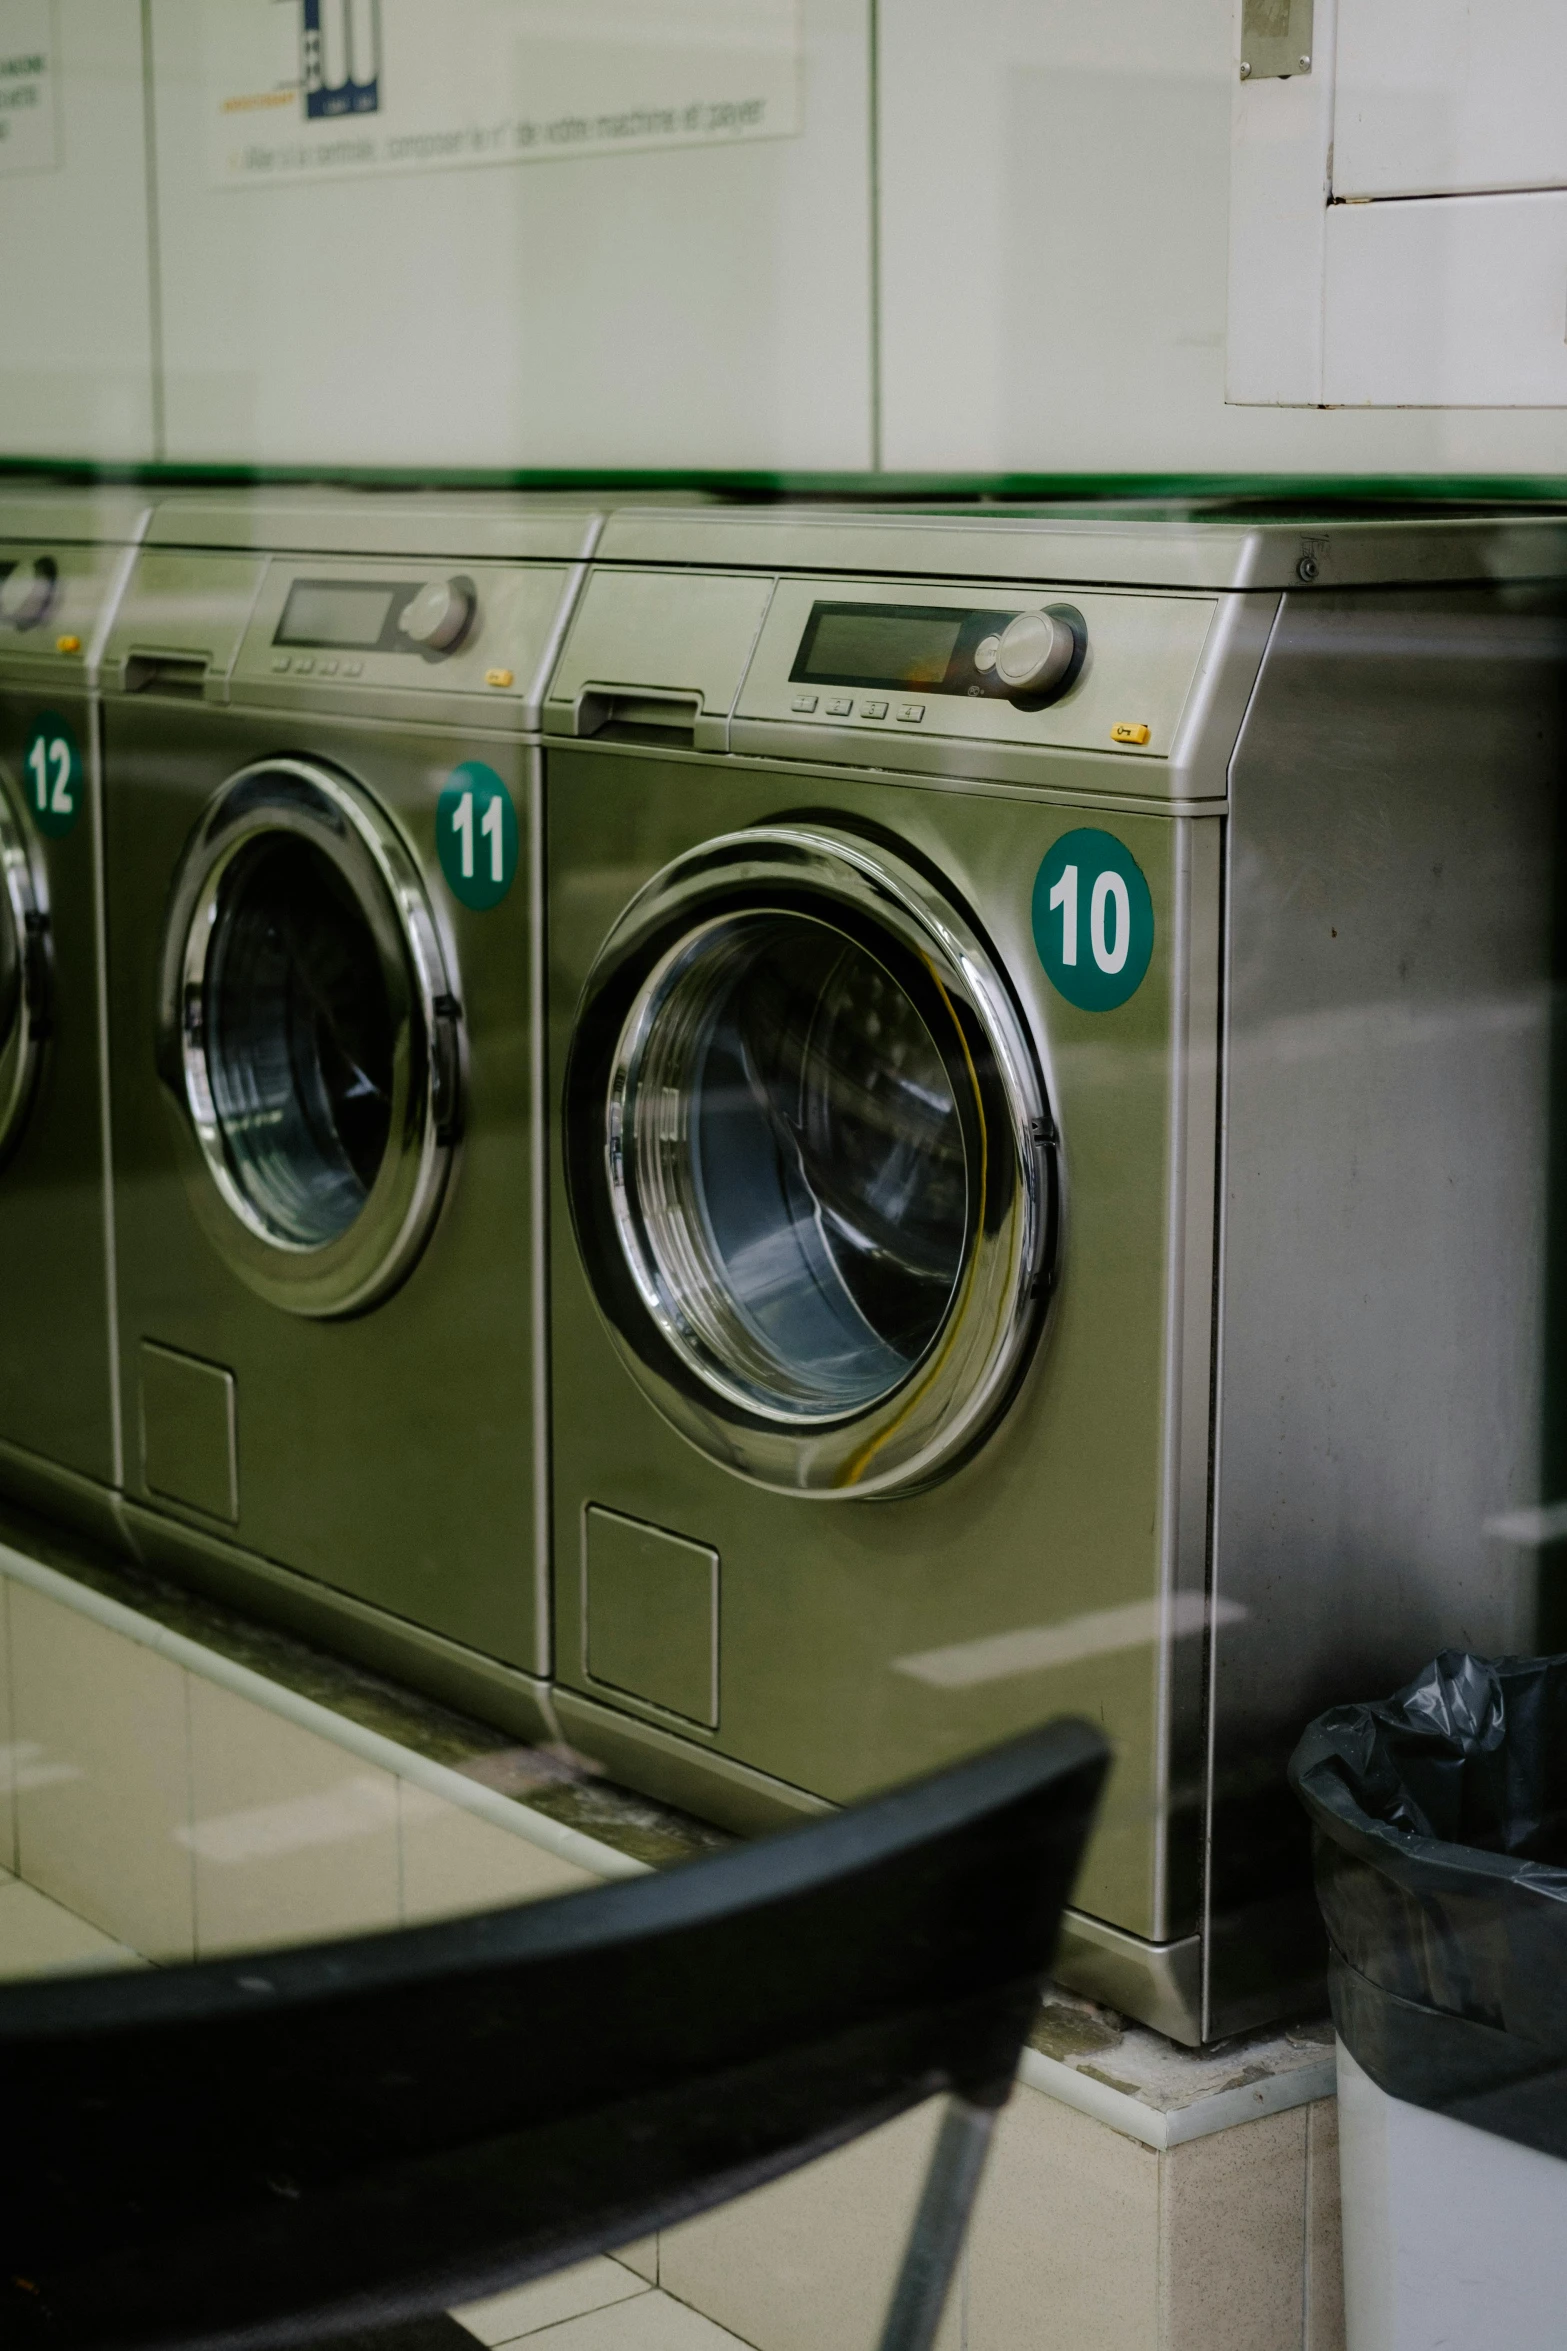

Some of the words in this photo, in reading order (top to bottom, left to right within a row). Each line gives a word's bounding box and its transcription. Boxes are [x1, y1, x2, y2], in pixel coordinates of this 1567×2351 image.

[518, 120, 537, 147] de
[546, 117, 588, 143] votre
[597, 108, 675, 137] machine
[708, 98, 766, 137] payer
[29, 736, 73, 813] 12
[452, 791, 503, 882] 11
[1049, 864, 1131, 974] 10
